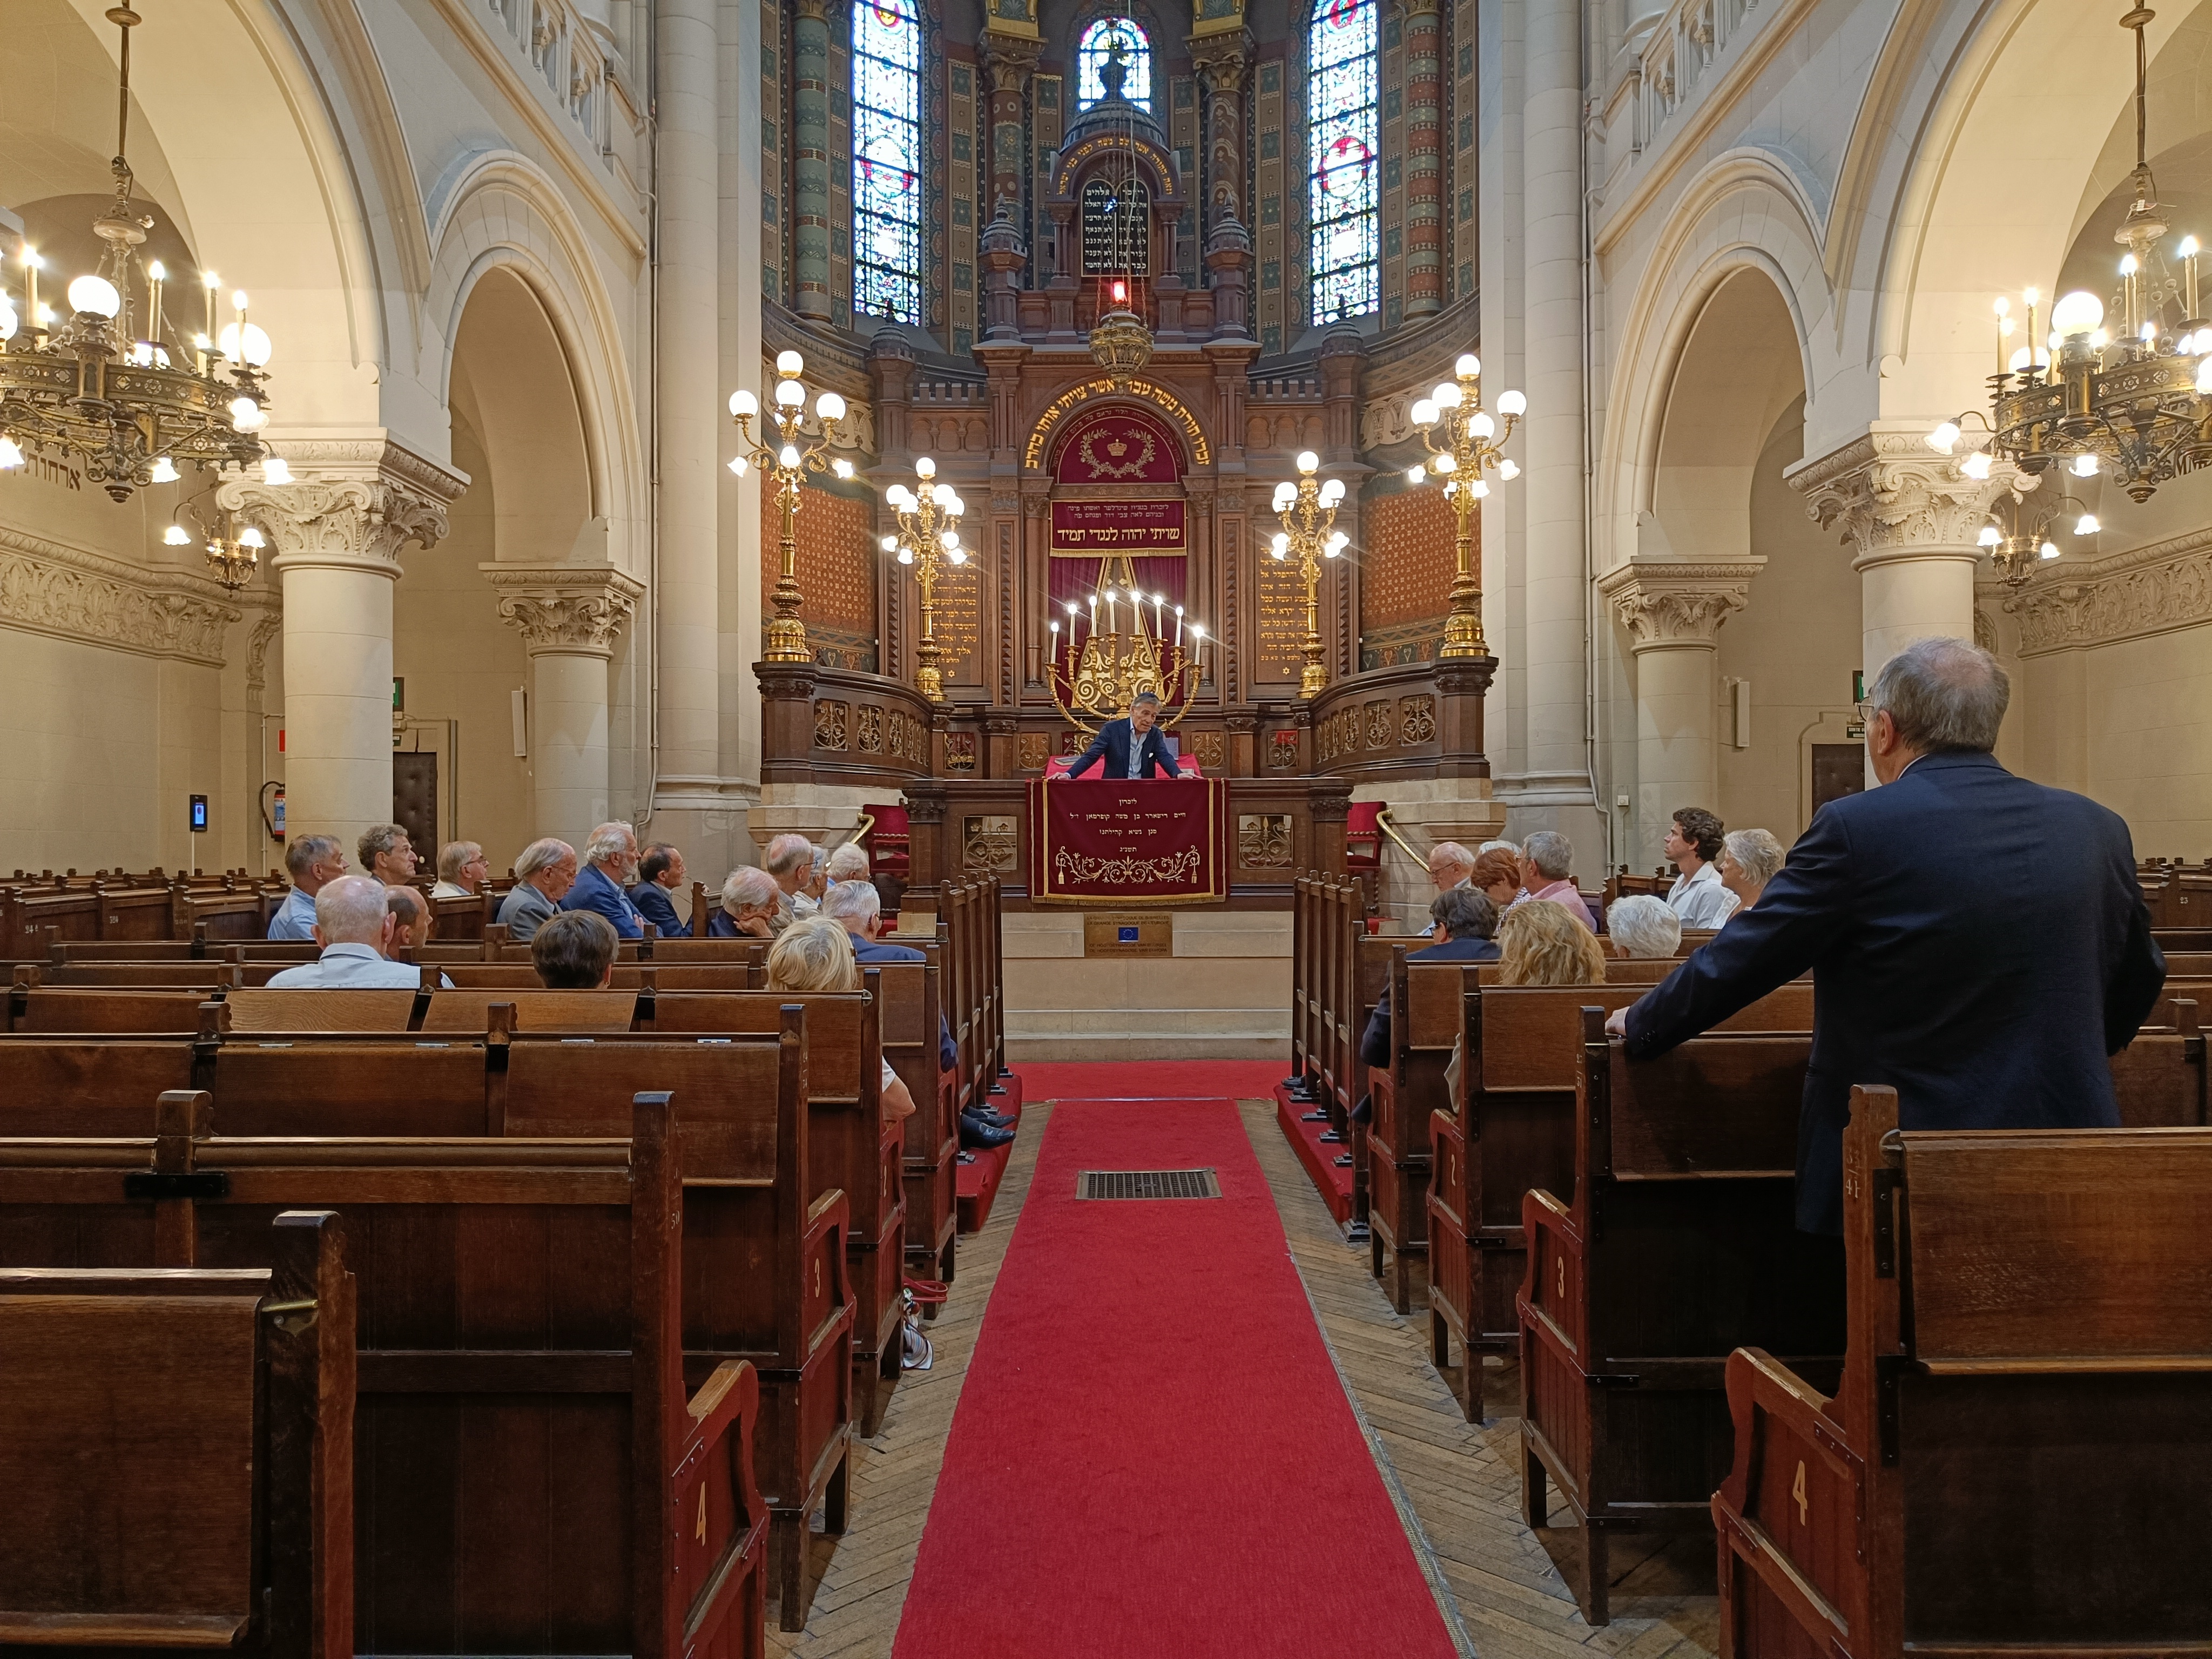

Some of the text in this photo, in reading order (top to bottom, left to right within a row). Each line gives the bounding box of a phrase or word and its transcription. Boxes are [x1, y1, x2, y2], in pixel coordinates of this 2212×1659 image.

[1097, 138, 1113, 147] משה
[1135, 141, 1149, 154] אשר
[1077, 143, 1092, 156] לפני
[1066, 158, 1078, 168] בני
[1150, 153, 1168, 174] התורה
[1056, 172, 1068, 195] ישראל
[1163, 177, 1172, 194] וזאת
[1087, 186, 1110, 195] אלהים
[1103, 212, 1112, 221] לא
[1103, 224, 1112, 233] לא
[1103, 235, 1112, 244] לא
[1103, 247, 1112, 256] לא
[1103, 259, 1112, 268] לא
[1024, 379, 1210, 469] זכרו תורת משה עבד אשר צויתי אותו בחרב
[1057, 527, 1179, 541] שויתי יהוה לנגדי תמיד
[948, 571, 964, 581] היכל
[967, 572, 976, 581] אל
[1260, 569, 1269, 578] אל
[1260, 593, 1273, 603] ככל
[1260, 605, 1276, 615] אליך
[1279, 608, 1294, 616] יקרא
[1273, 617, 1280, 626] כל
[961, 633, 977, 643] מלכי
[956, 645, 971, 656] אליך
[1119, 798, 1137, 806] לזכרון
[1451, 1154, 1456, 1186] 2
[814, 1258, 820, 1298] 3
[1557, 1256, 1564, 1298] 3
[1792, 1460, 1808, 1527] 4
[696, 1481, 706, 1547] 4
